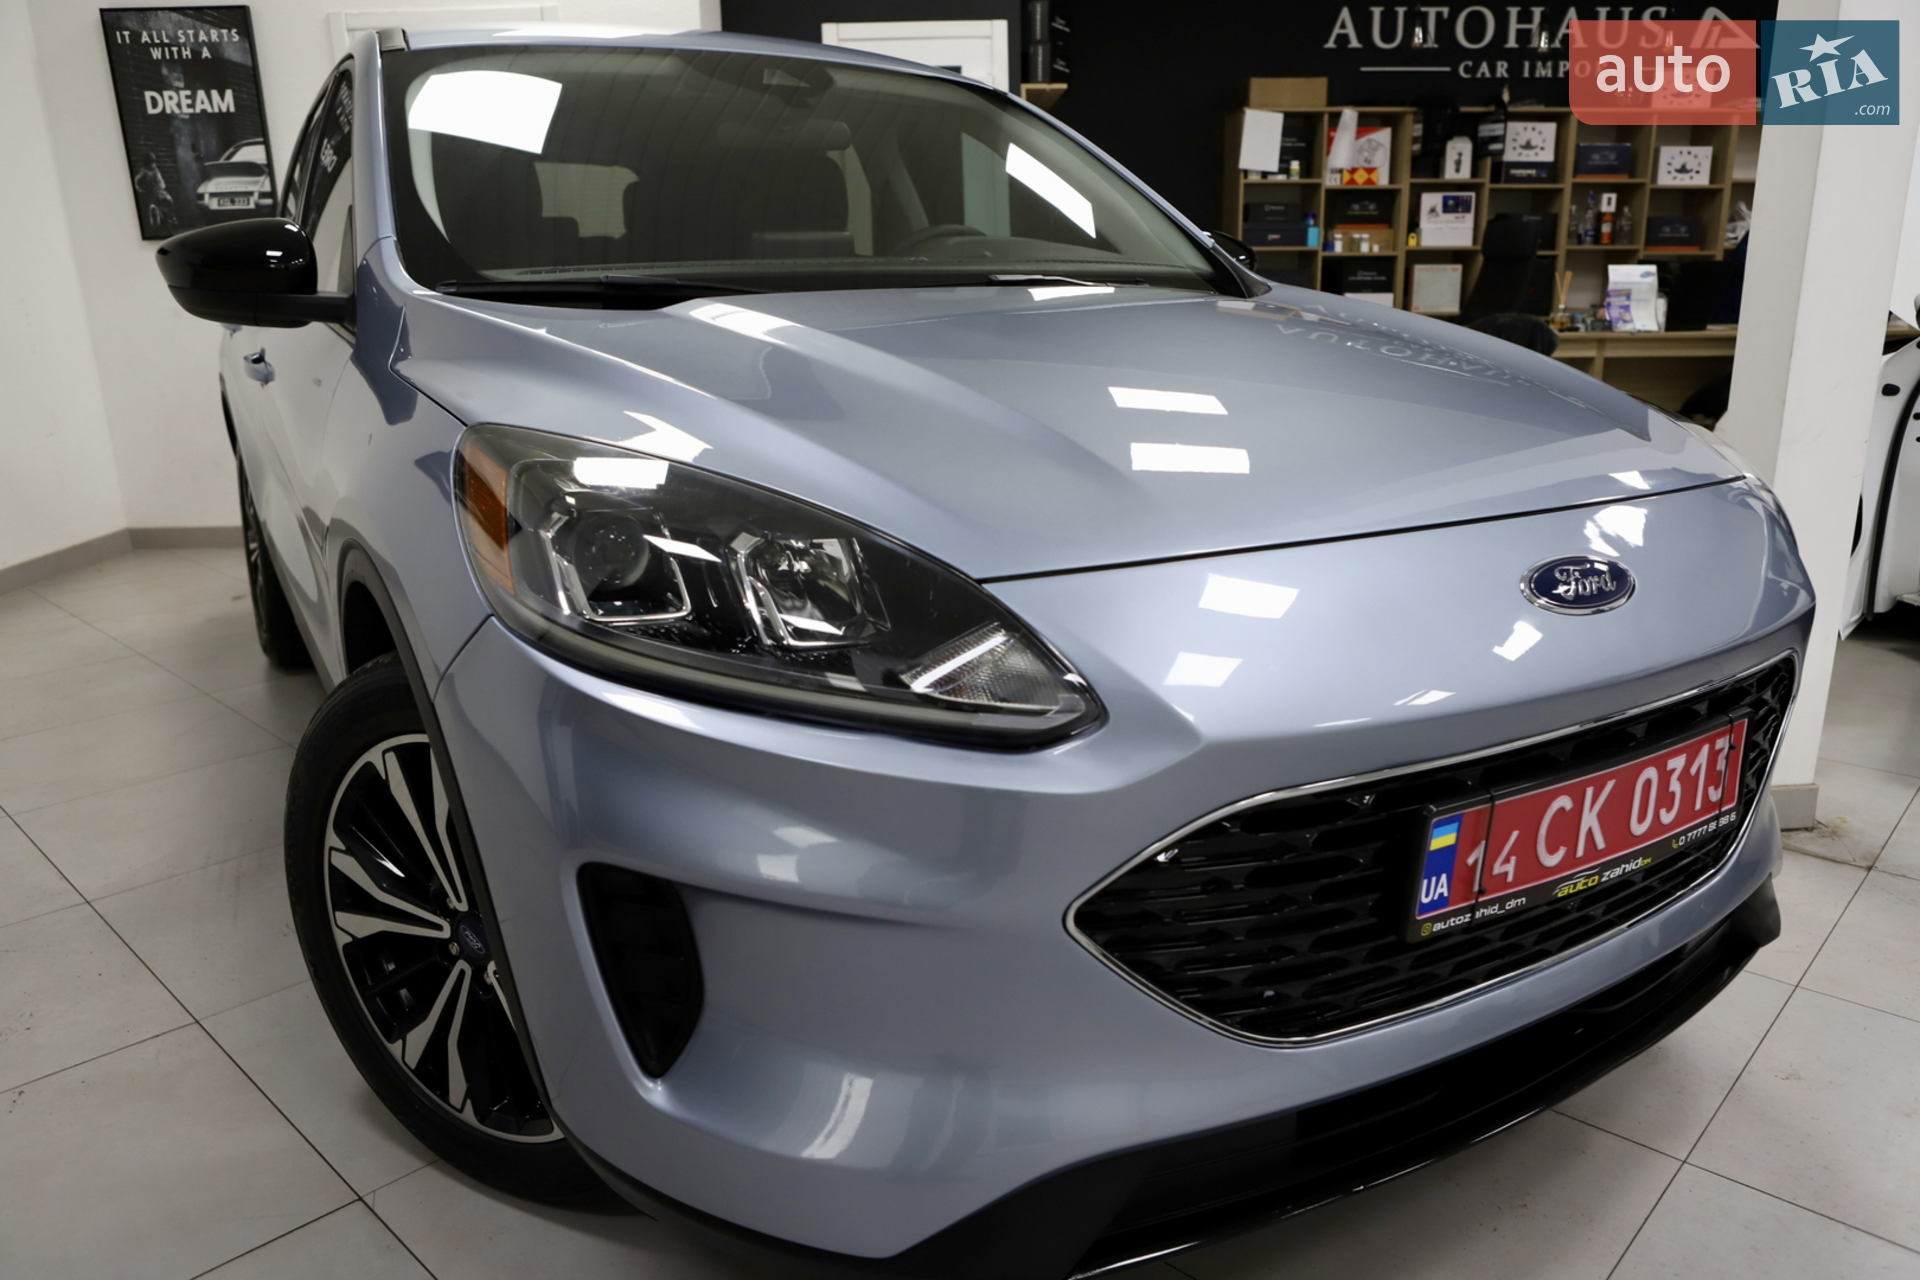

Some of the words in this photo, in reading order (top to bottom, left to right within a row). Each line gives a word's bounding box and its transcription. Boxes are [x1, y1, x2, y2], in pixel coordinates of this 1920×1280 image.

[116, 30, 131, 44] IT
[141, 30, 170, 44] ALL
[178, 28, 240, 43] STARTS
[1323, 5, 1668, 50] AUTOHAUS
[150, 46, 192, 60] WITH
[201, 46, 212, 59] A
[1458, 61, 1510, 79] CAR
[144, 88, 236, 115] DREAM
[1551, 562, 1617, 601] Ford
[1466, 829, 1520, 894] 14
[1536, 779, 1616, 869] CK
[1629, 735, 1732, 837] 0313
[1421, 873, 1449, 904] UA
[1557, 874, 1600, 898] auto
[1601, 856, 1643, 883] zahid
